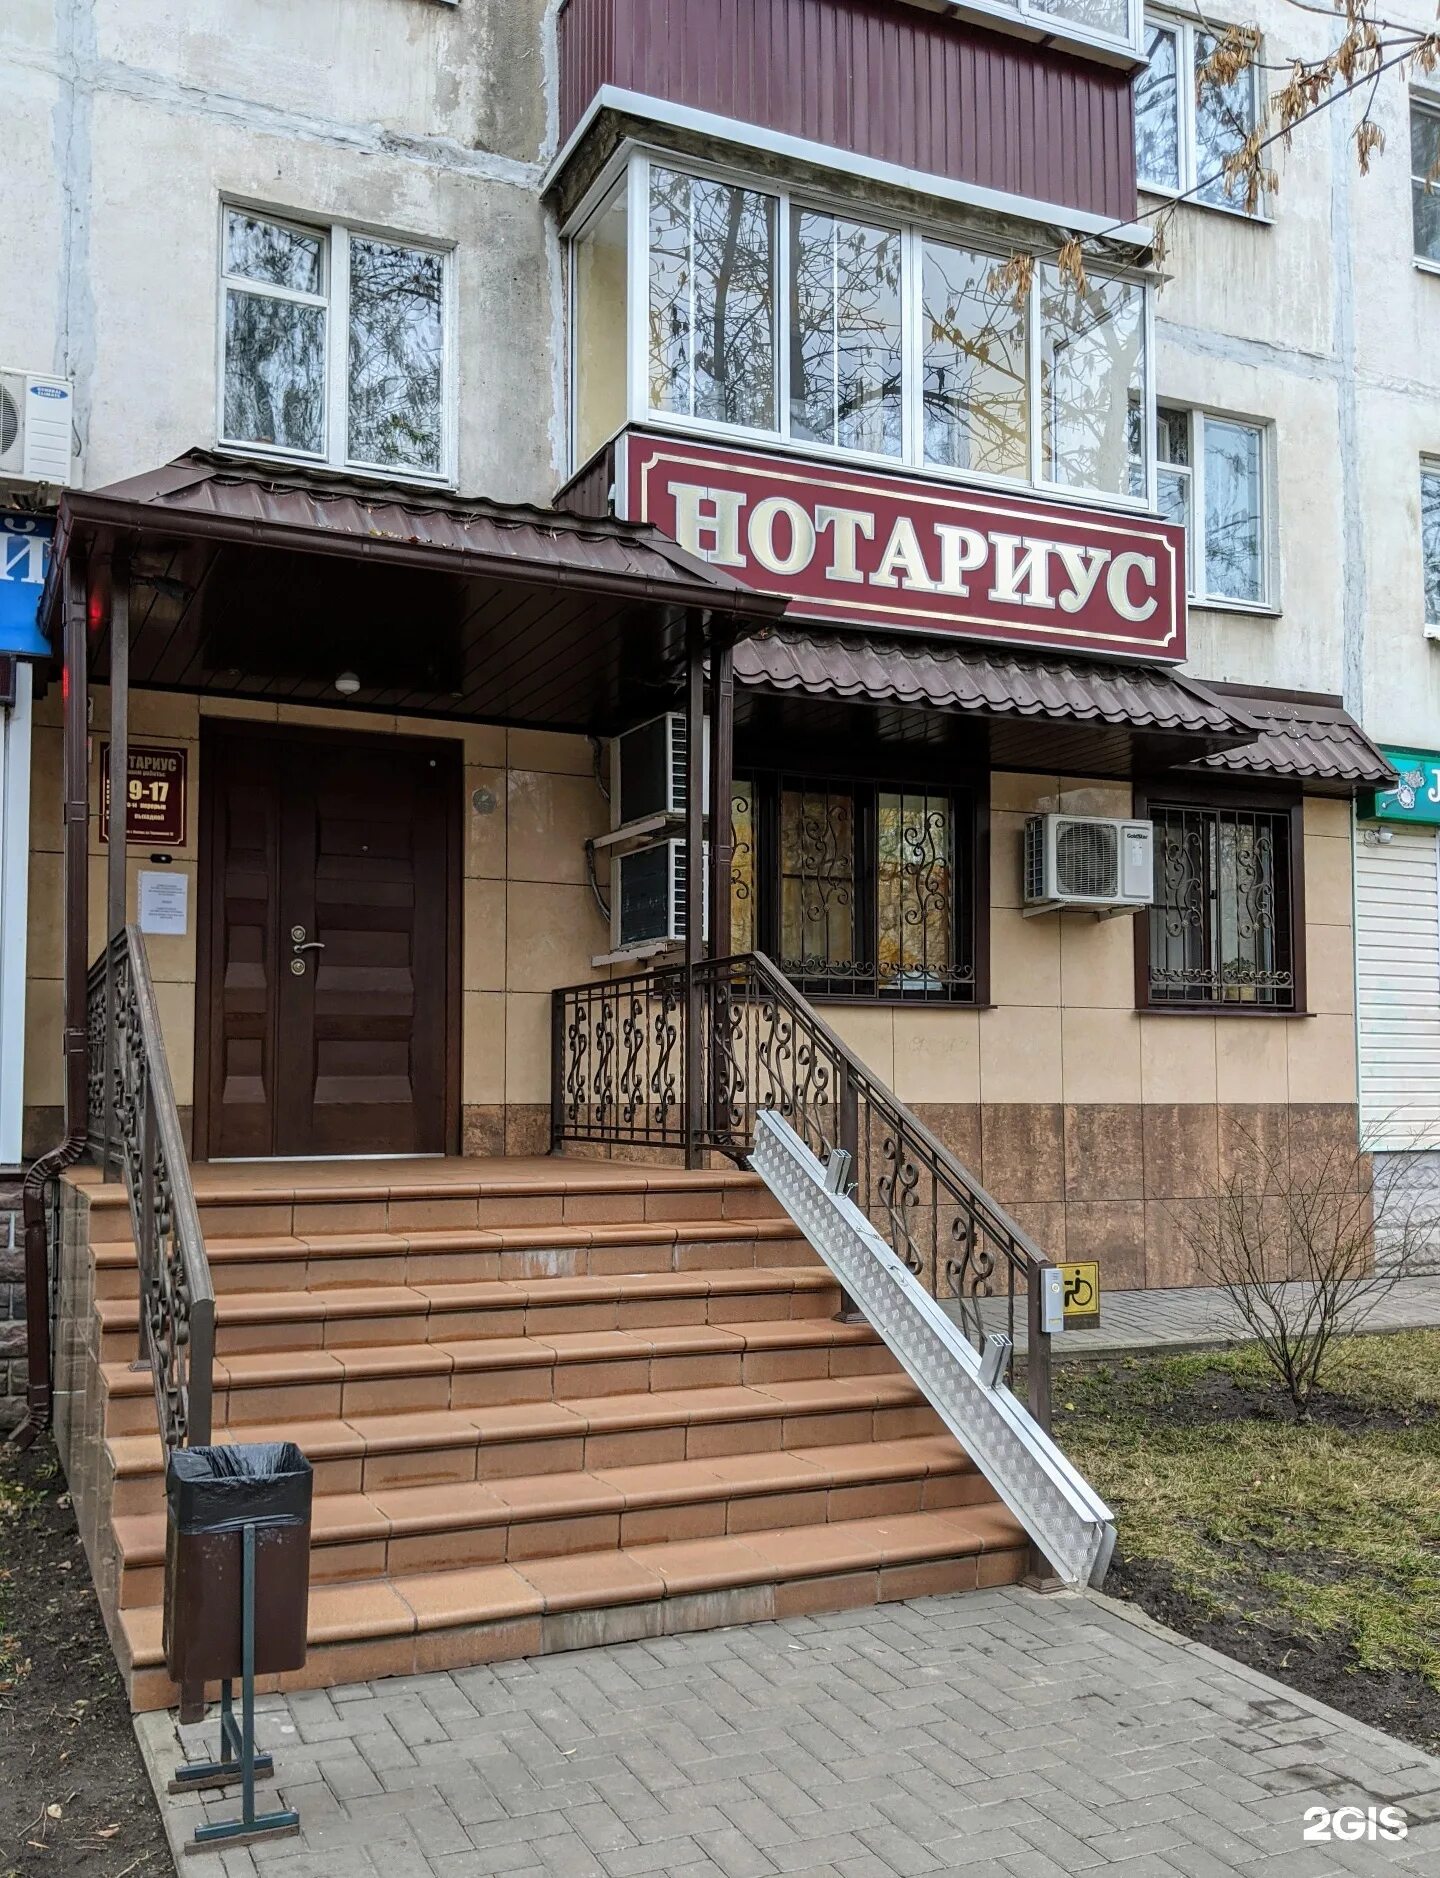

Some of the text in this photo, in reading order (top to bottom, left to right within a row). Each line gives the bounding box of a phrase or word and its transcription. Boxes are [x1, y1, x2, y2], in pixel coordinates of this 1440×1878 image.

[667, 481, 1158, 622] НОТАРИУС
[128, 755, 177, 772] ТАРИУС
[129, 780, 168, 802] 9-17
